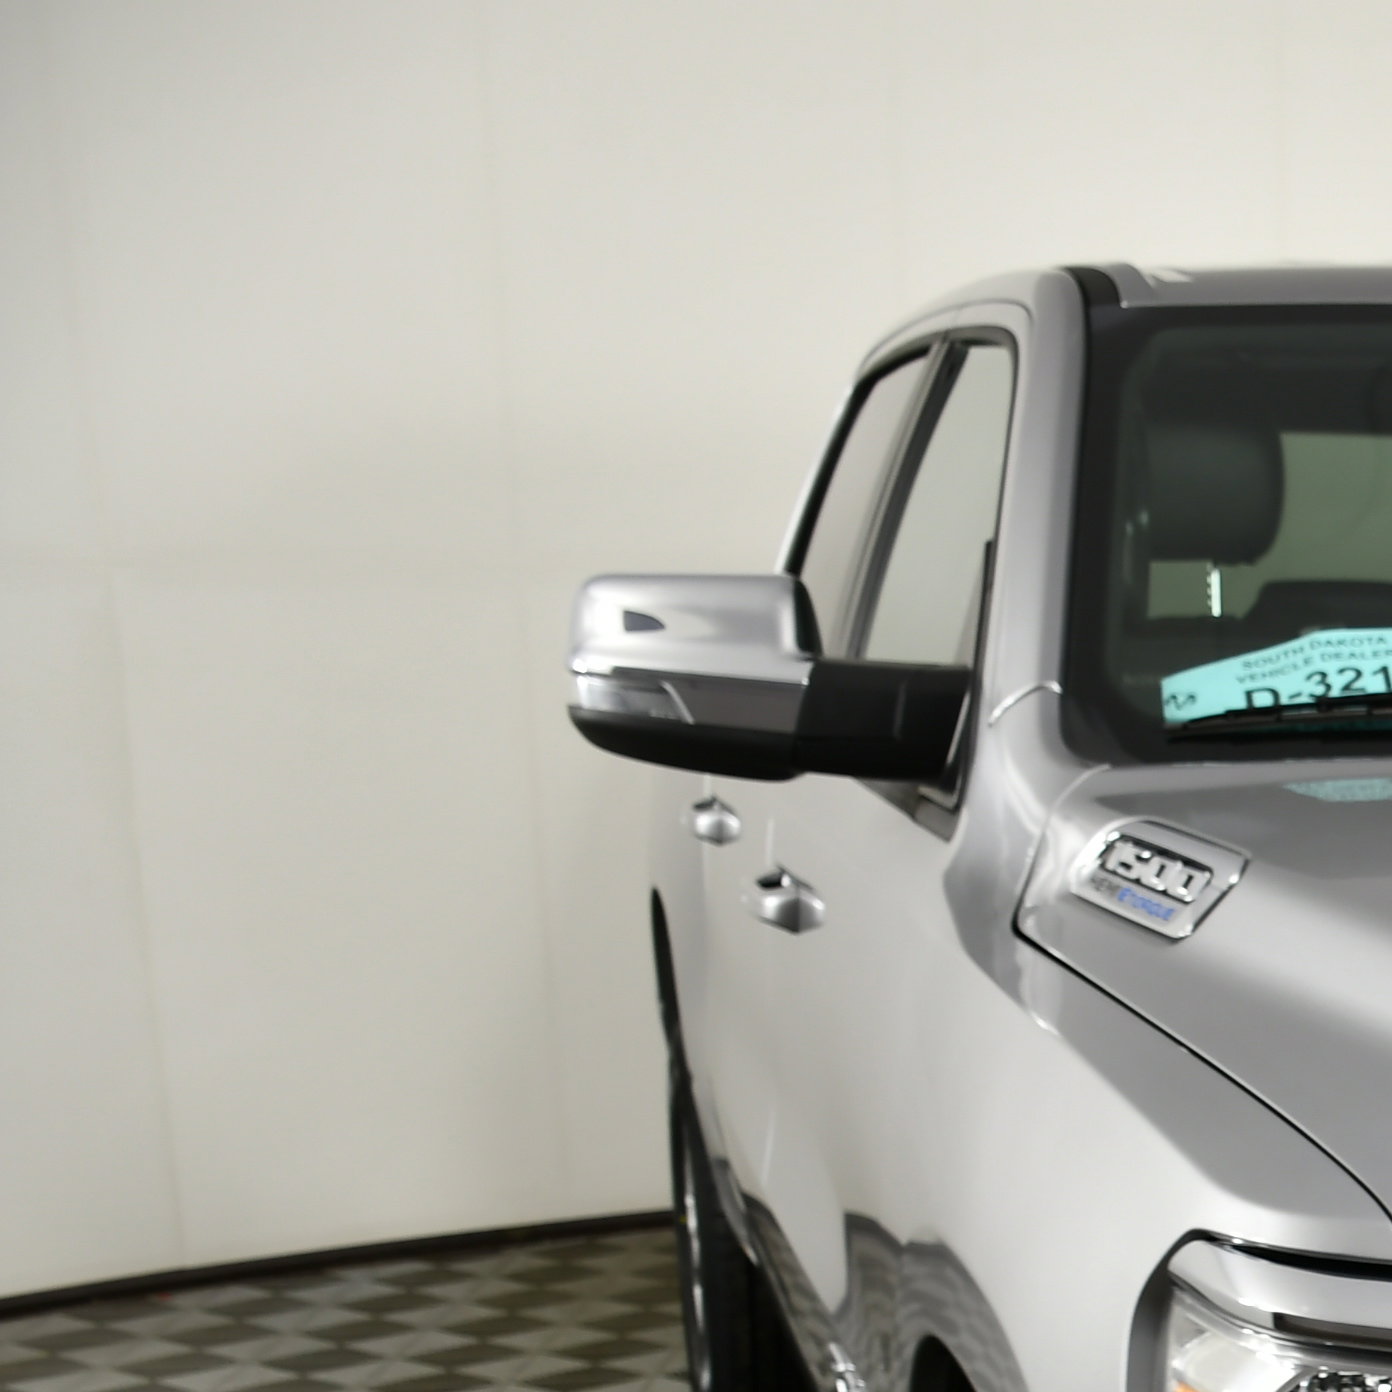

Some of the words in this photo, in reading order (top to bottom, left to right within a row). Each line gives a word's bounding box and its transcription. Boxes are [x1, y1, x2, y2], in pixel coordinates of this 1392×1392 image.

[1241, 646, 1304, 671] SOUTH
[1309, 635, 1387, 651] DAKOTA
[1235, 656, 1314, 685] VEHICLE
